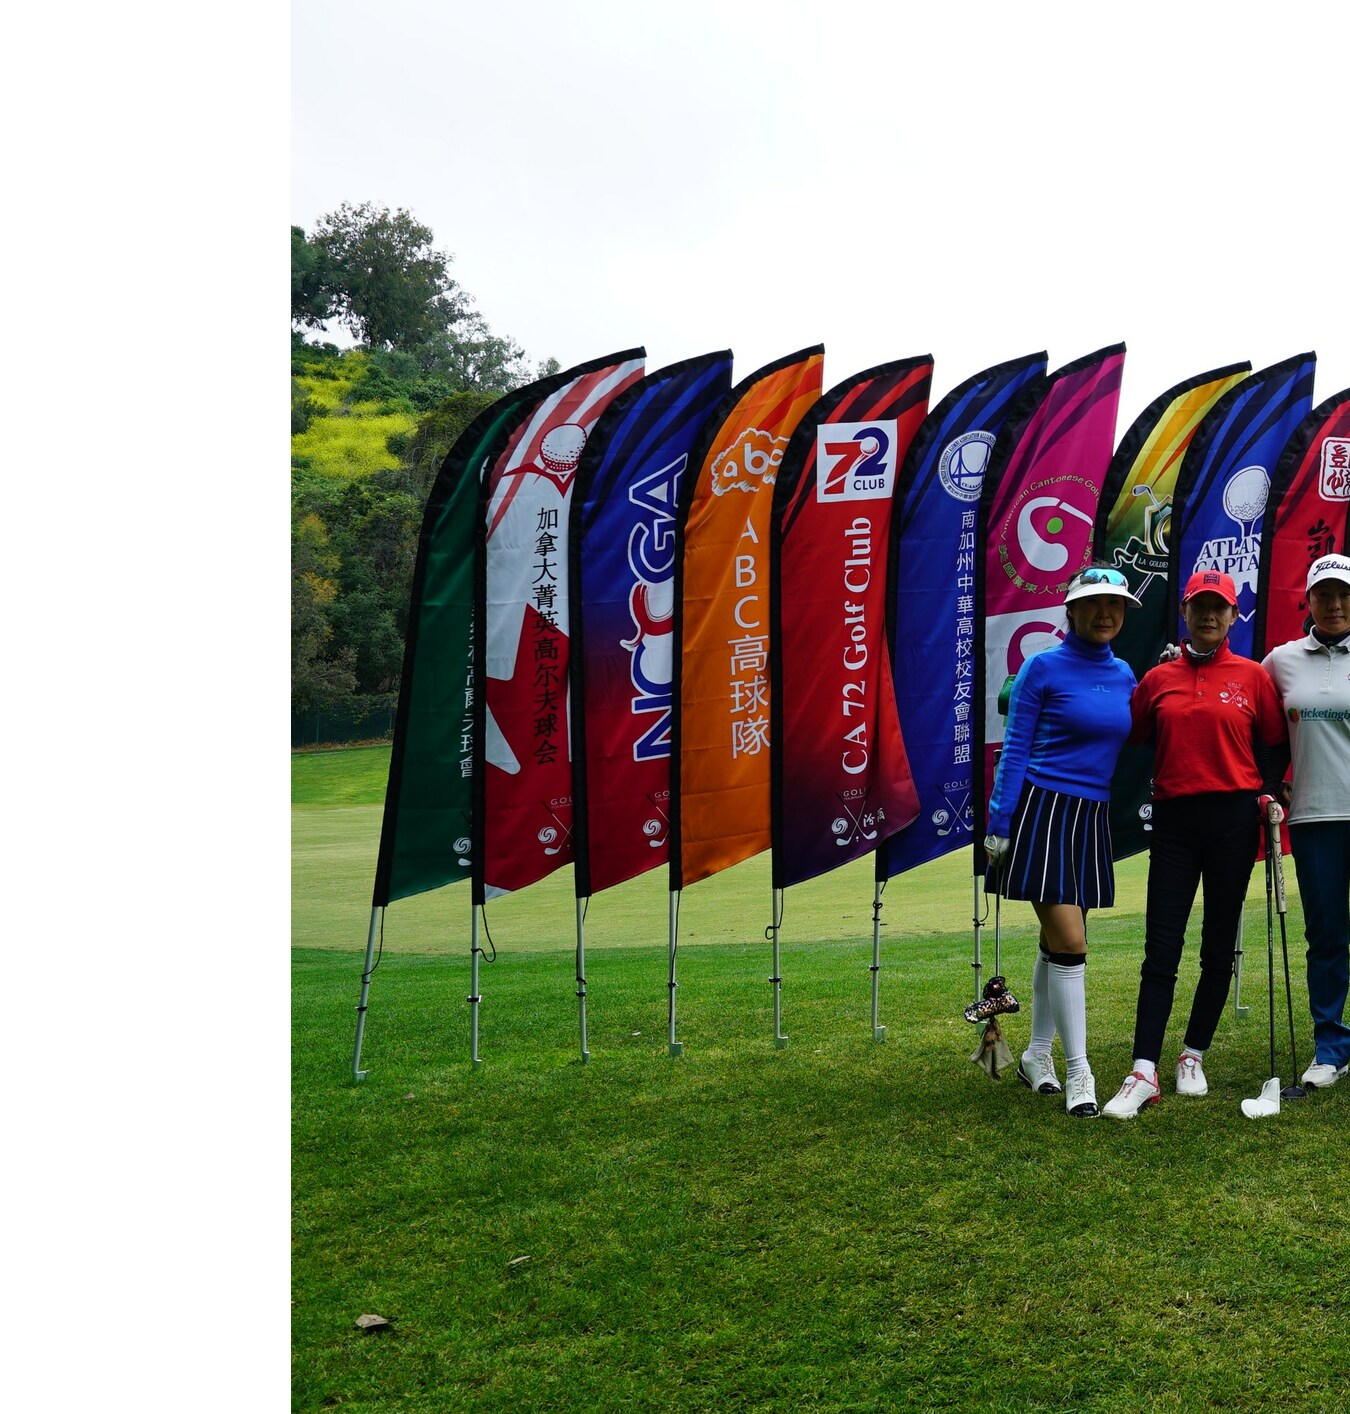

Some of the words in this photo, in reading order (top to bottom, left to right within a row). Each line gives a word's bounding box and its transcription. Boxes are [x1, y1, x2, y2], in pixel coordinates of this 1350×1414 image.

[723, 443, 784, 478] abc
[823, 427, 889, 495] 72
[1030, 474, 1084, 491] Cantonese
[854, 478, 885, 491] CLUB
[844, 517, 872, 593] Club
[1138, 557, 1148, 566] LA
[531, 507, 559, 766] 加拿大菁英高尔夫球会
[843, 600, 868, 670] Golf
[953, 510, 975, 765] 南加州中華高校校友會聯盟
[842, 680, 866, 716] 72
[842, 721, 868, 774] CA
[944, 779, 970, 789] GOLF
